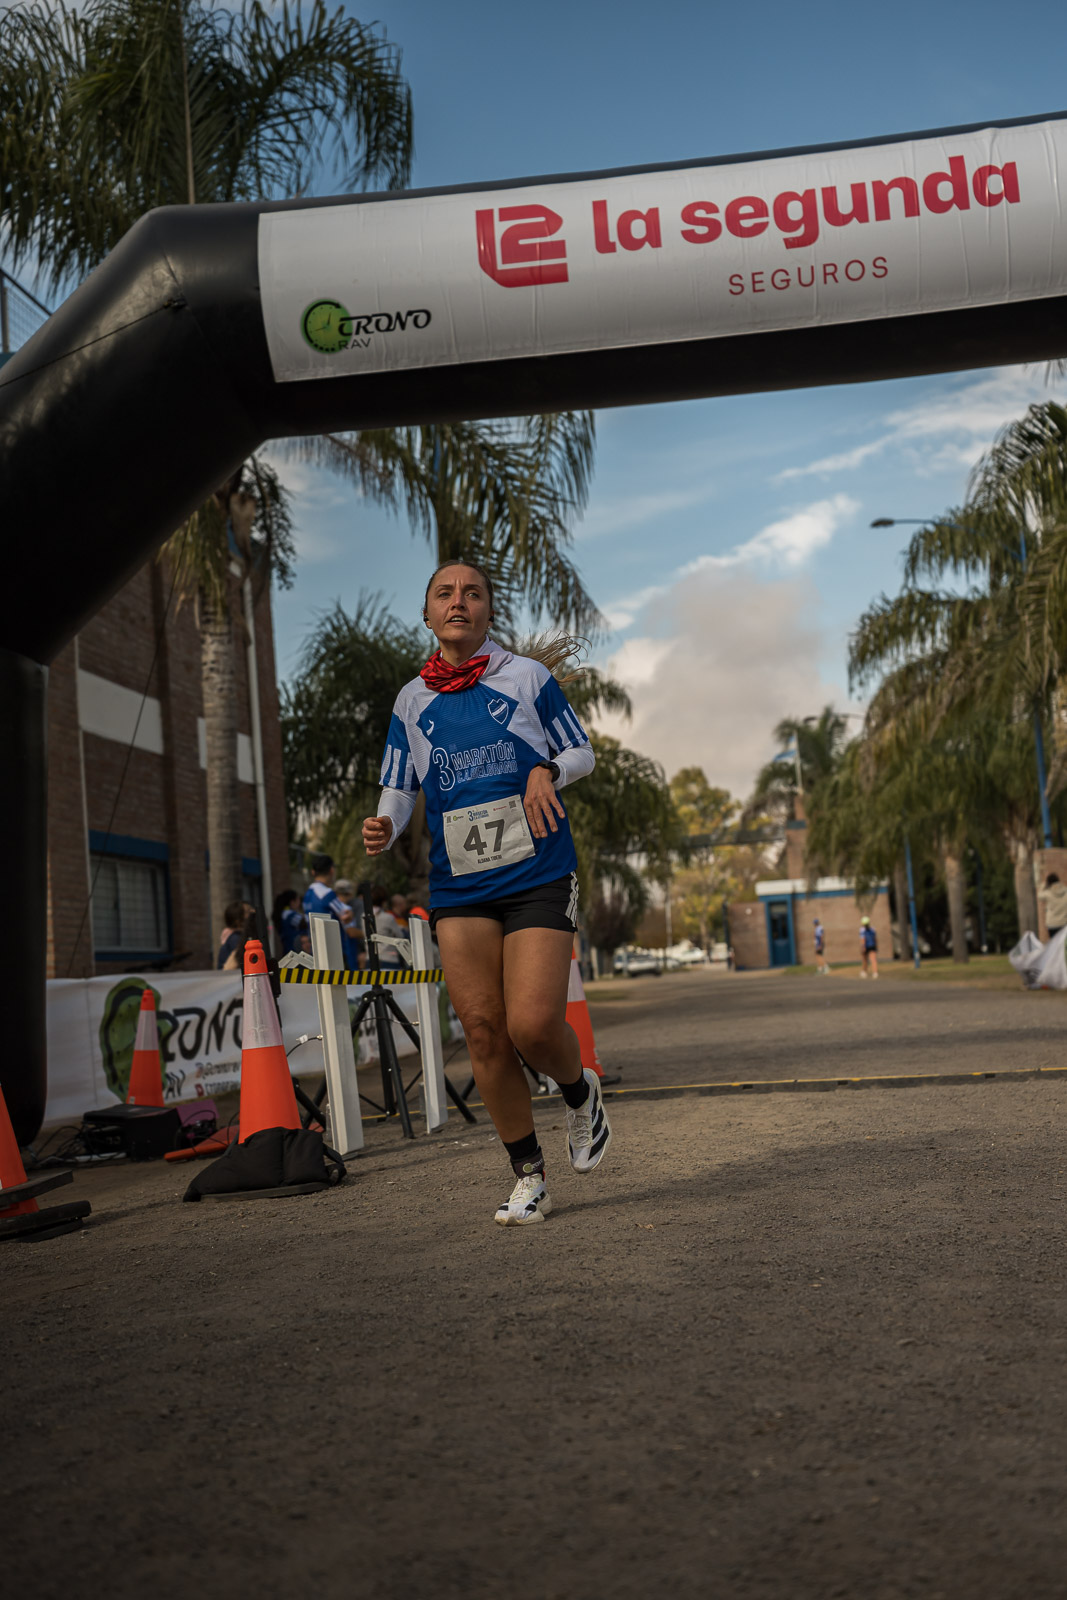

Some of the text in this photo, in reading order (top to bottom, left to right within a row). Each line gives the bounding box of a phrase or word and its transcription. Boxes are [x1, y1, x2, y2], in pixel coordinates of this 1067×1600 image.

[592, 154, 1021, 254] la segunda
[728, 256, 889, 295] SEGUROS
[338, 309, 432, 337] CRONO
[338, 338, 371, 350] RAV
[432, 740, 516, 792] 3 MARATÓN
[463, 818, 505, 856] 47
